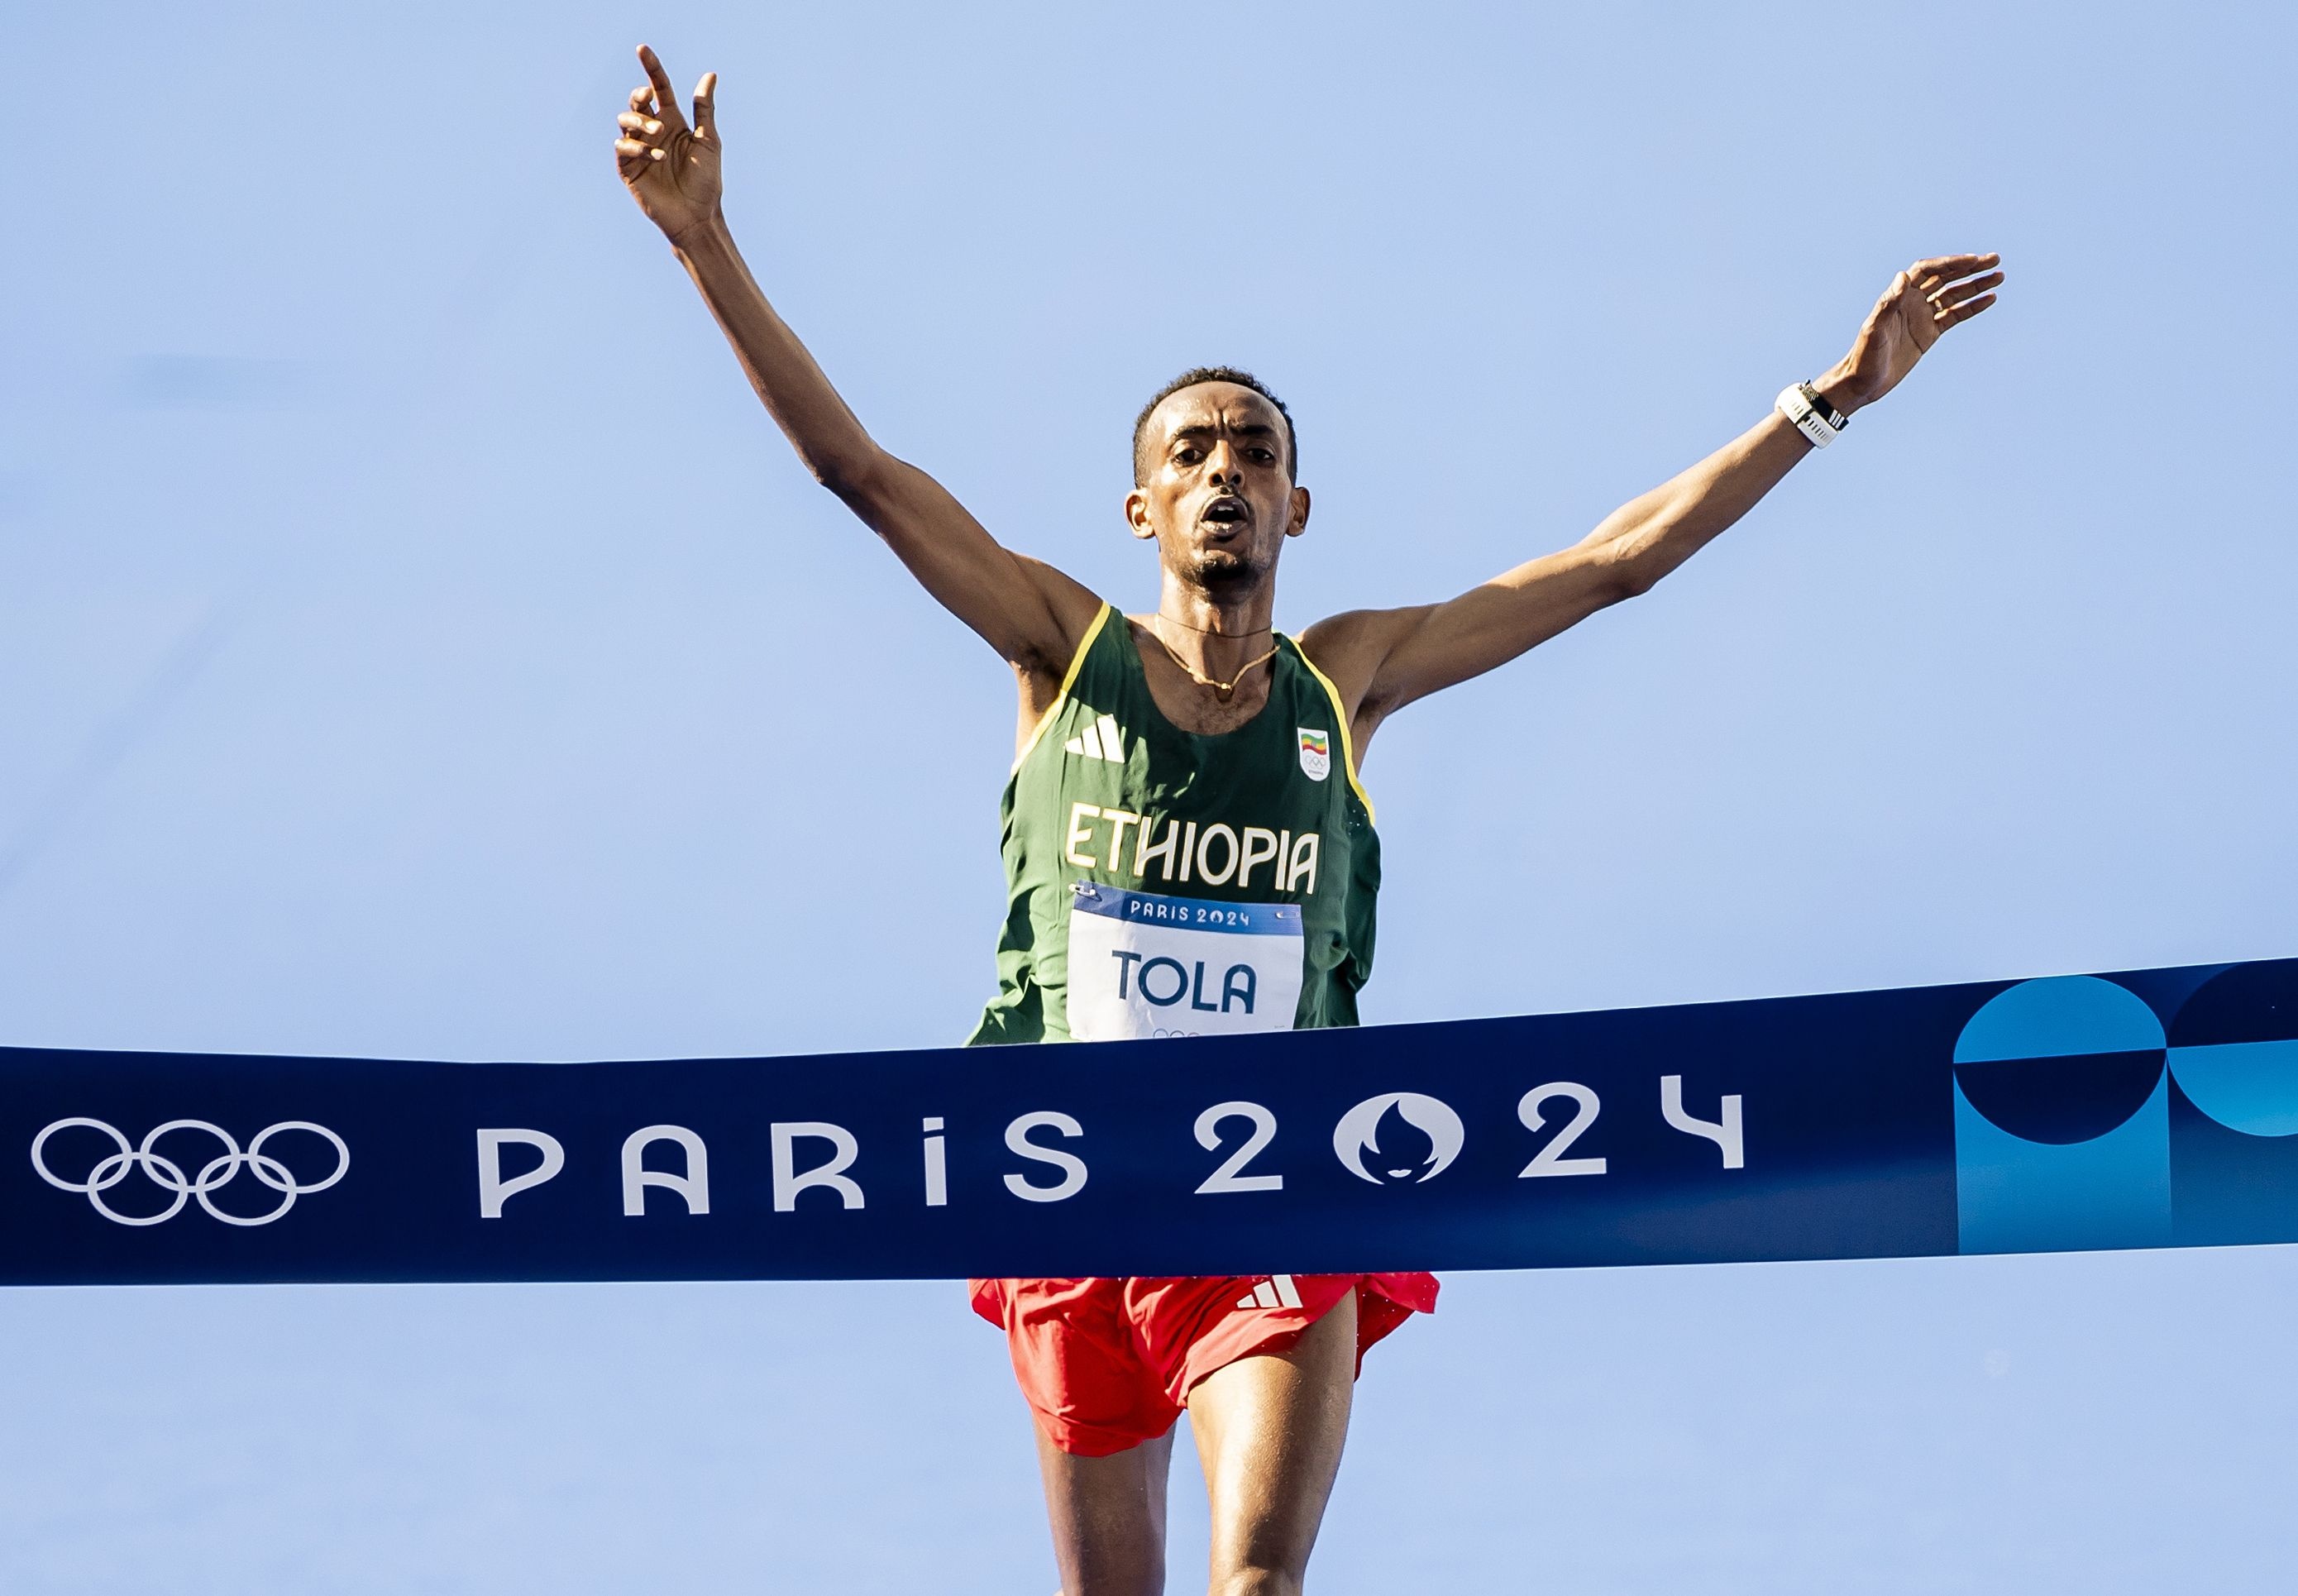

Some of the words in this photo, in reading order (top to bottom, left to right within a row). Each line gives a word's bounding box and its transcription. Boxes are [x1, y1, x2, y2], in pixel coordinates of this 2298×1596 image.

[1066, 801, 1319, 895] ETHIOPIA
[1197, 907, 1250, 926] 2024
[1111, 949, 1257, 1015] TOLA
[1193, 1075, 1745, 1195] 2024
